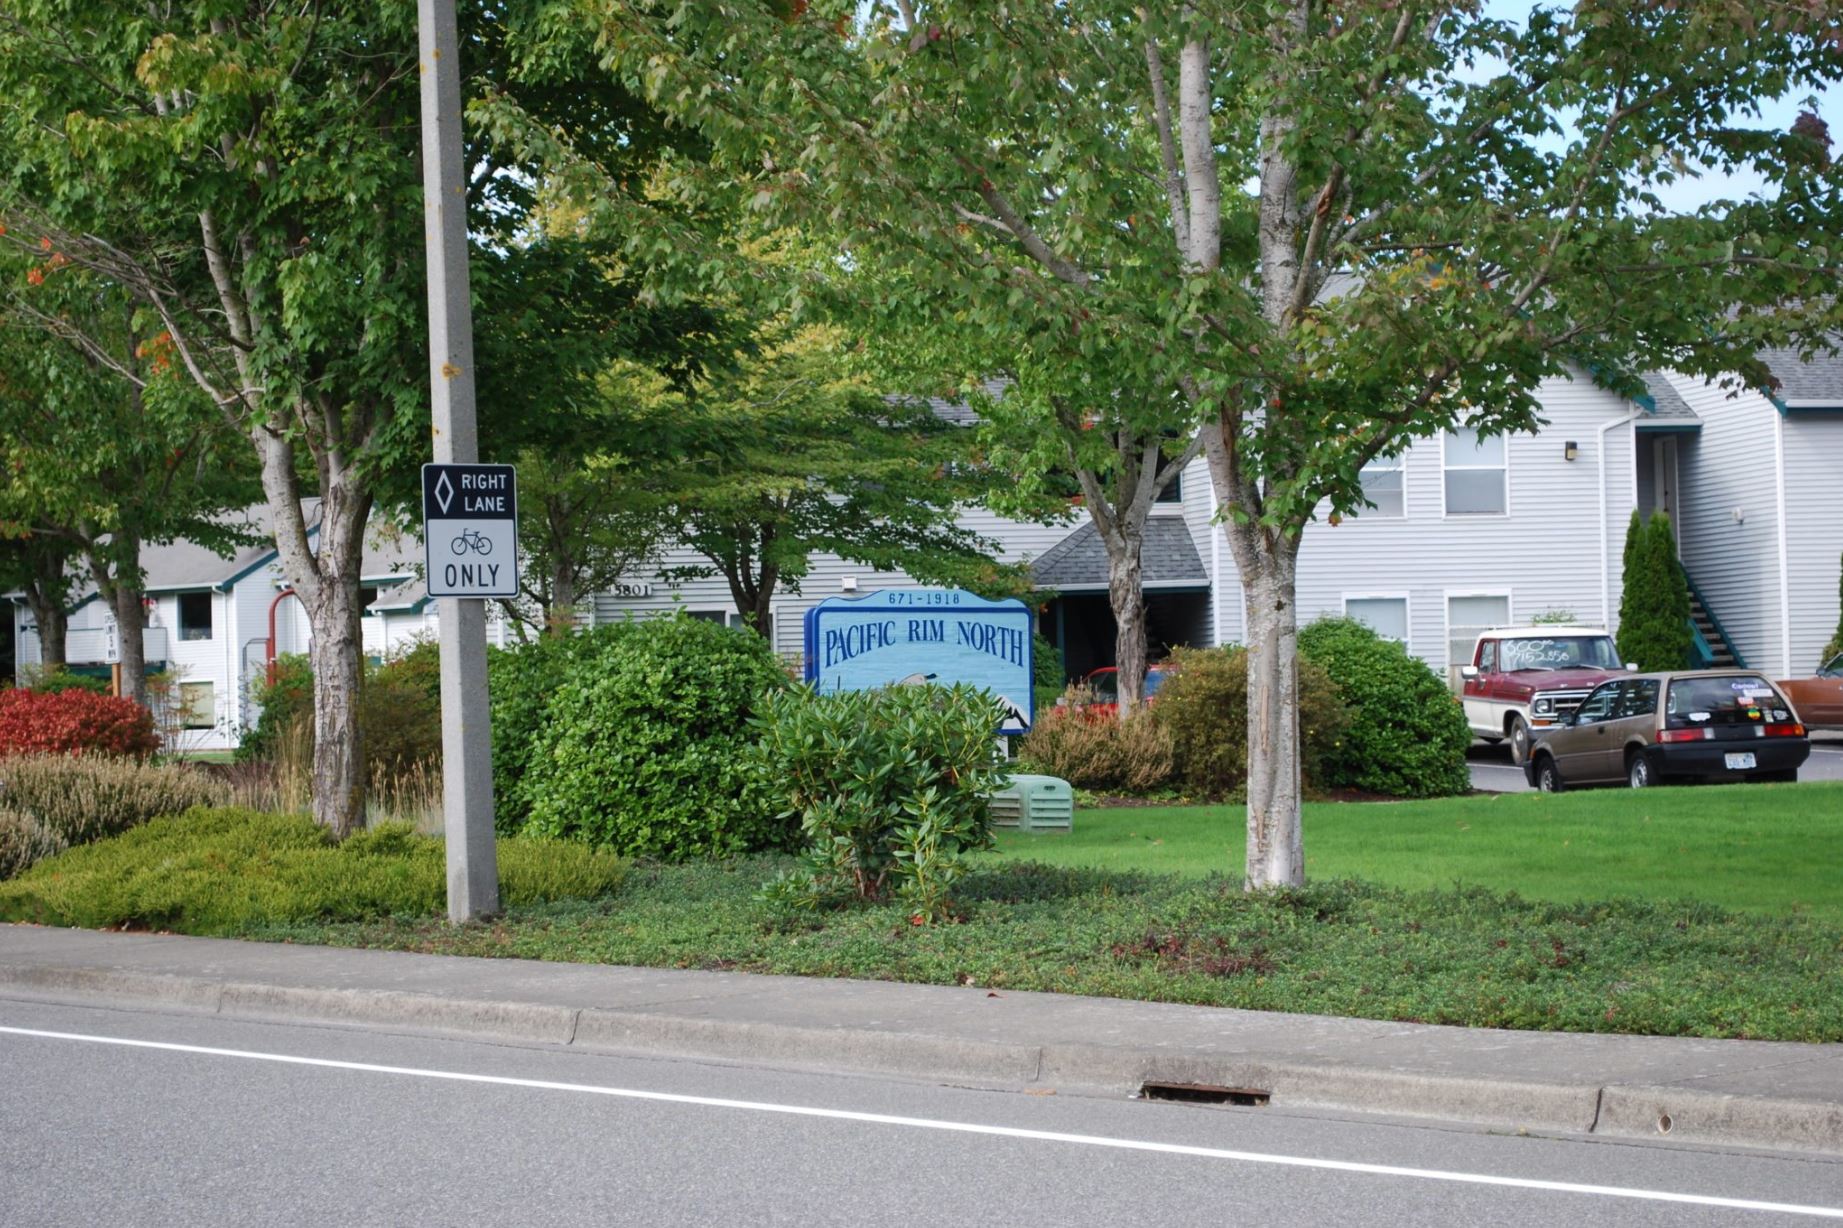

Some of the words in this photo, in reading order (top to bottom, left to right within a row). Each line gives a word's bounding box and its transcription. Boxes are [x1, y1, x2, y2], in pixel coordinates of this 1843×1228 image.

[461, 473, 507, 490] RIGHT
[464, 496, 506, 512] LANE
[445, 563, 500, 588] ONLY
[888, 593, 960, 605] 671-1918
[825, 620, 896, 668] PACIFIC
[908, 619, 945, 642] RIM
[957, 621, 1024, 667] NORTH
